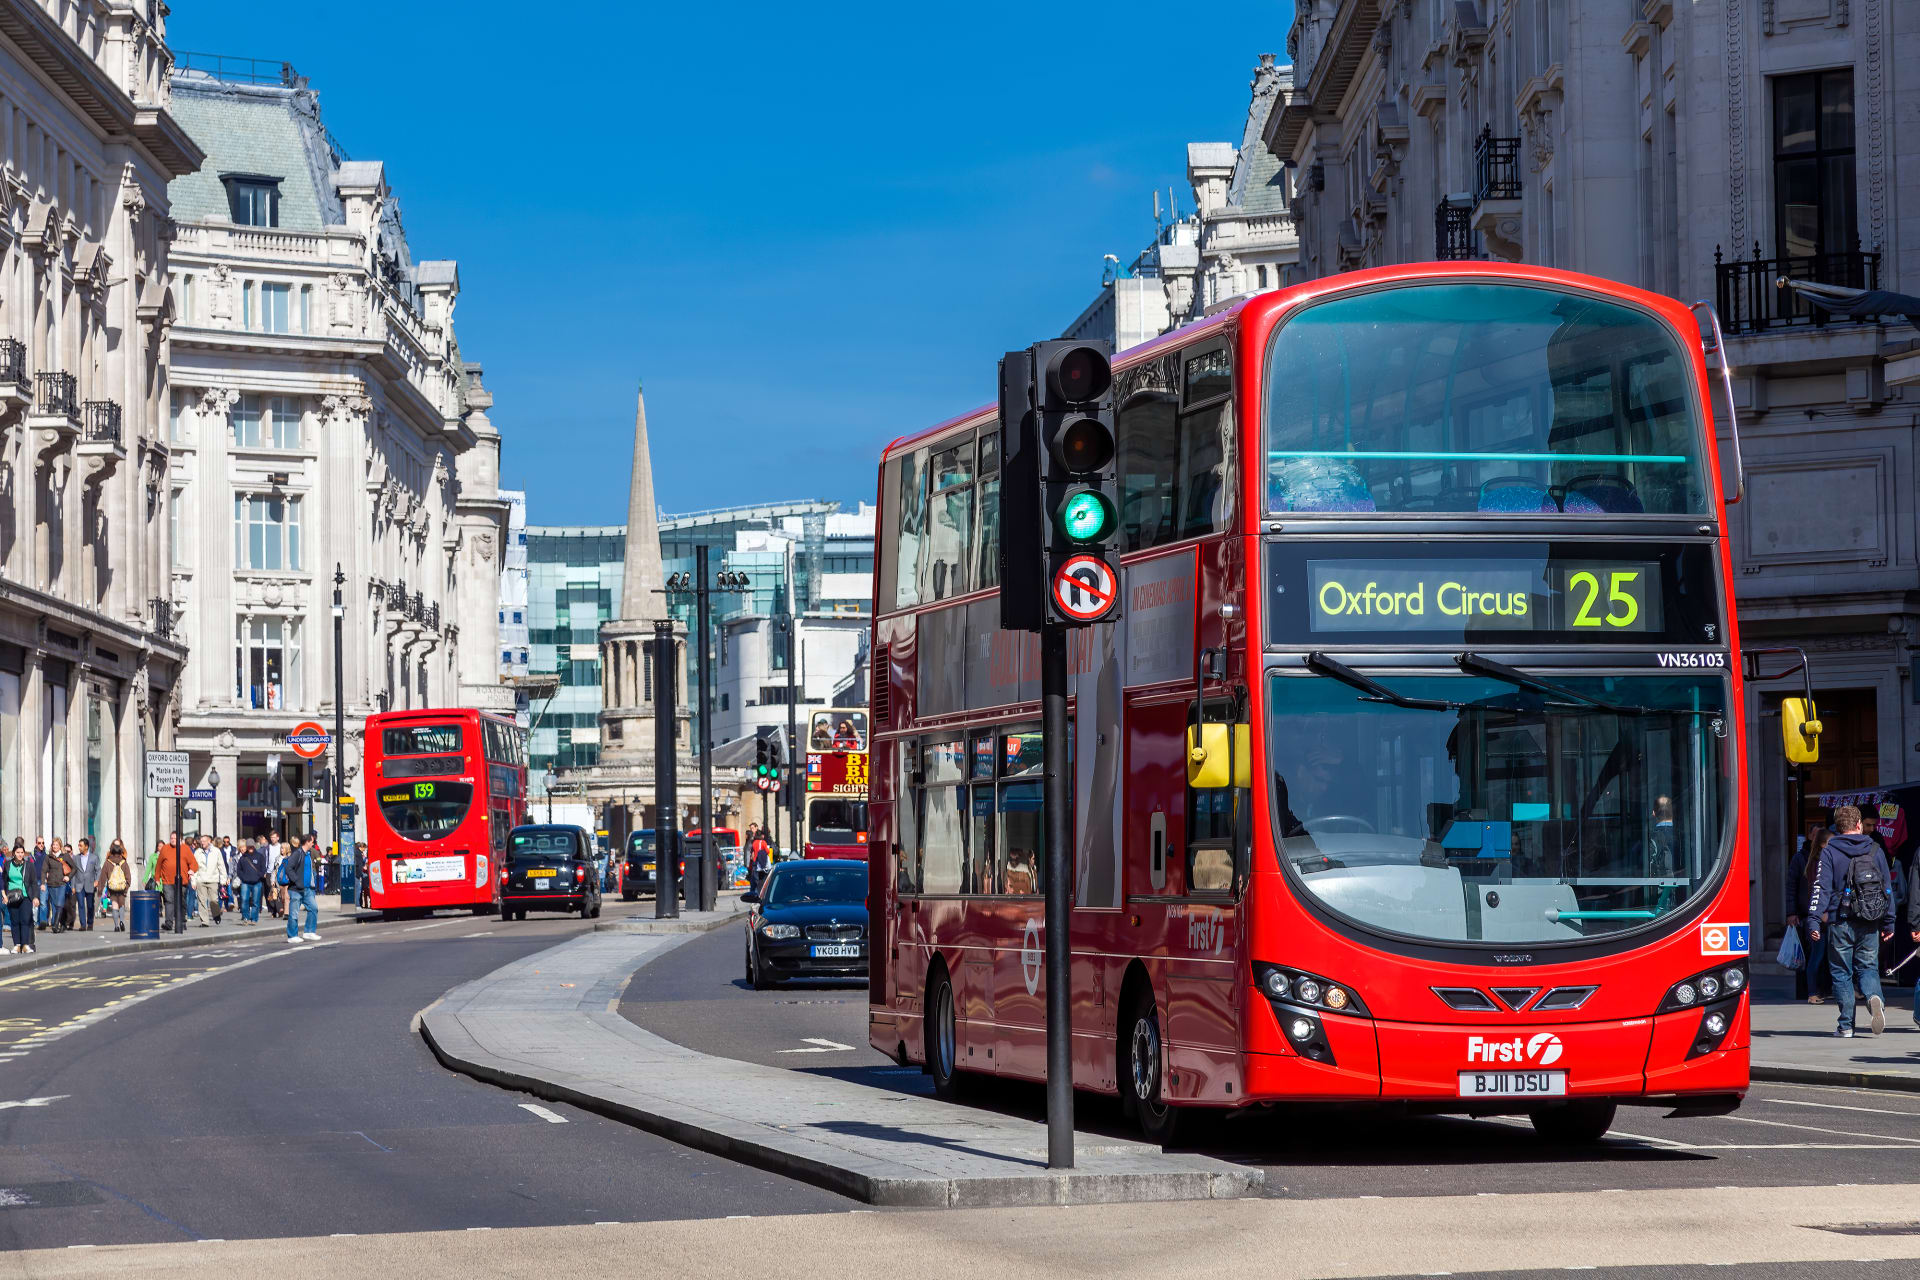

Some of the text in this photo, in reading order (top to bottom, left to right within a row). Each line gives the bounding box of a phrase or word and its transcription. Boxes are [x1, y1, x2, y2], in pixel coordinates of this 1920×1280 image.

[1319, 571, 1639, 627] Oxford Circus 25
[1657, 653, 1725, 667] VN36103
[148, 754, 188, 763] OXFORD CIRCUS
[156, 785, 171, 793] Euston
[414, 783, 434, 798] 139
[1188, 911, 1210, 951] First
[816, 946, 839, 956] YK08
[1467, 1036, 1523, 1062] First
[1475, 1074, 1550, 1093] BJ11 DSU
